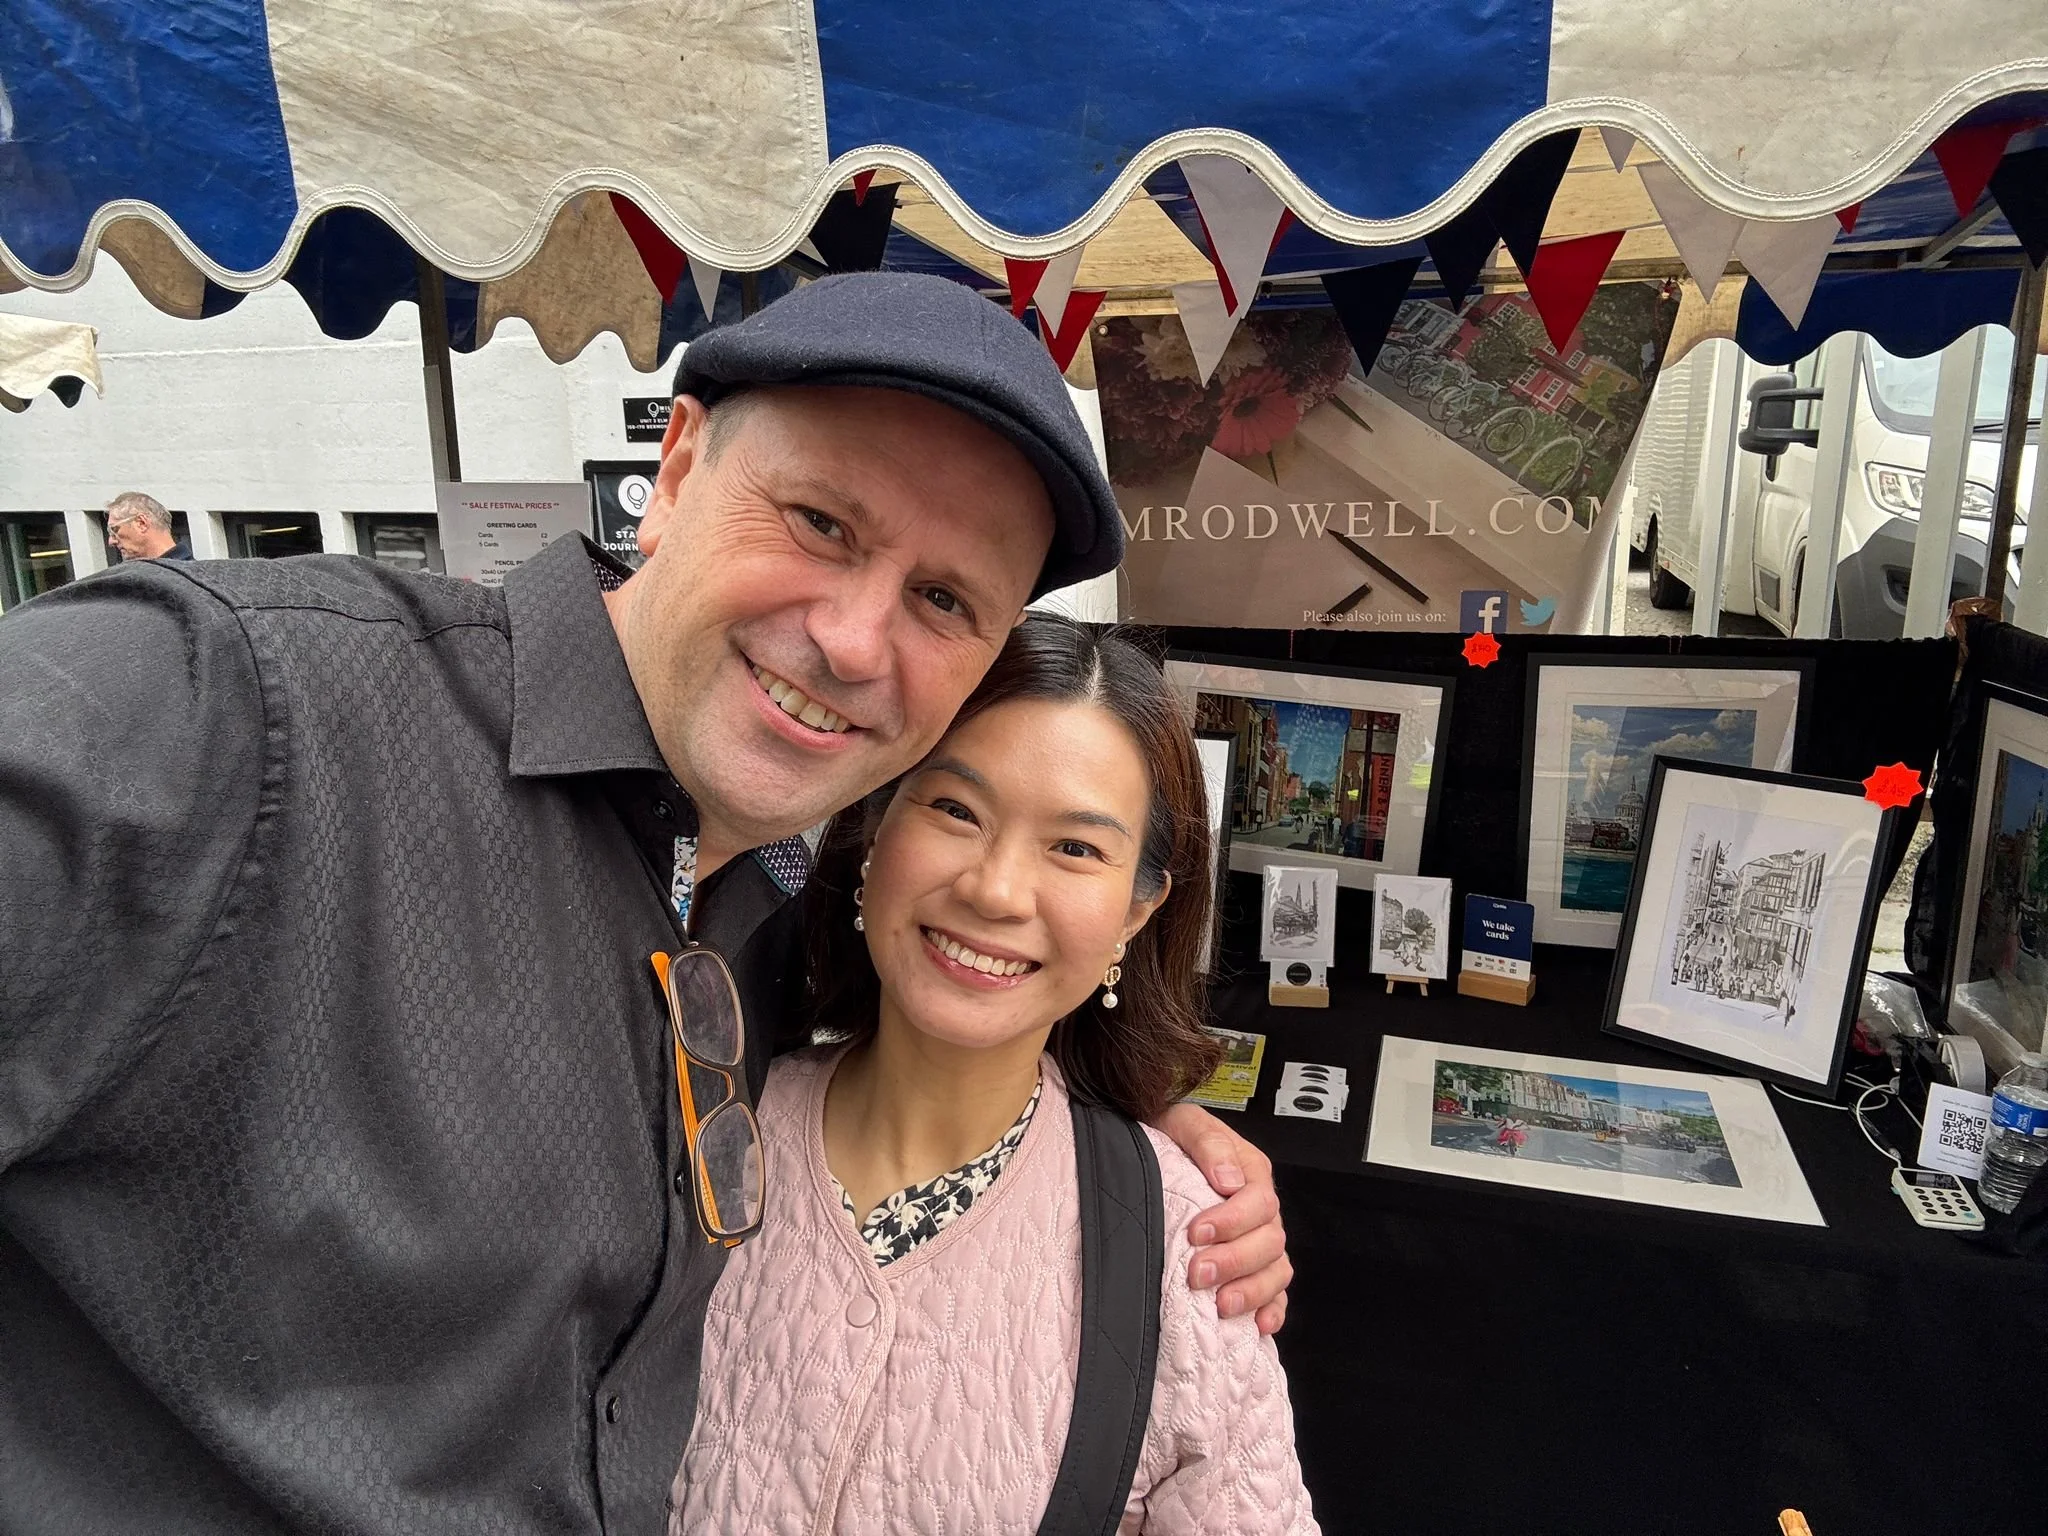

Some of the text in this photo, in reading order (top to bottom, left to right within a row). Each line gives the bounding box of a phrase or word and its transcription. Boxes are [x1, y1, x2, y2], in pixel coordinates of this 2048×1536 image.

[615, 530, 636, 539] STA
[602, 542, 639, 551] JOURN
[1303, 610, 1447, 625] Please also join us on:
[1482, 919, 1516, 933] We take
[1486, 930, 1510, 941] cards
